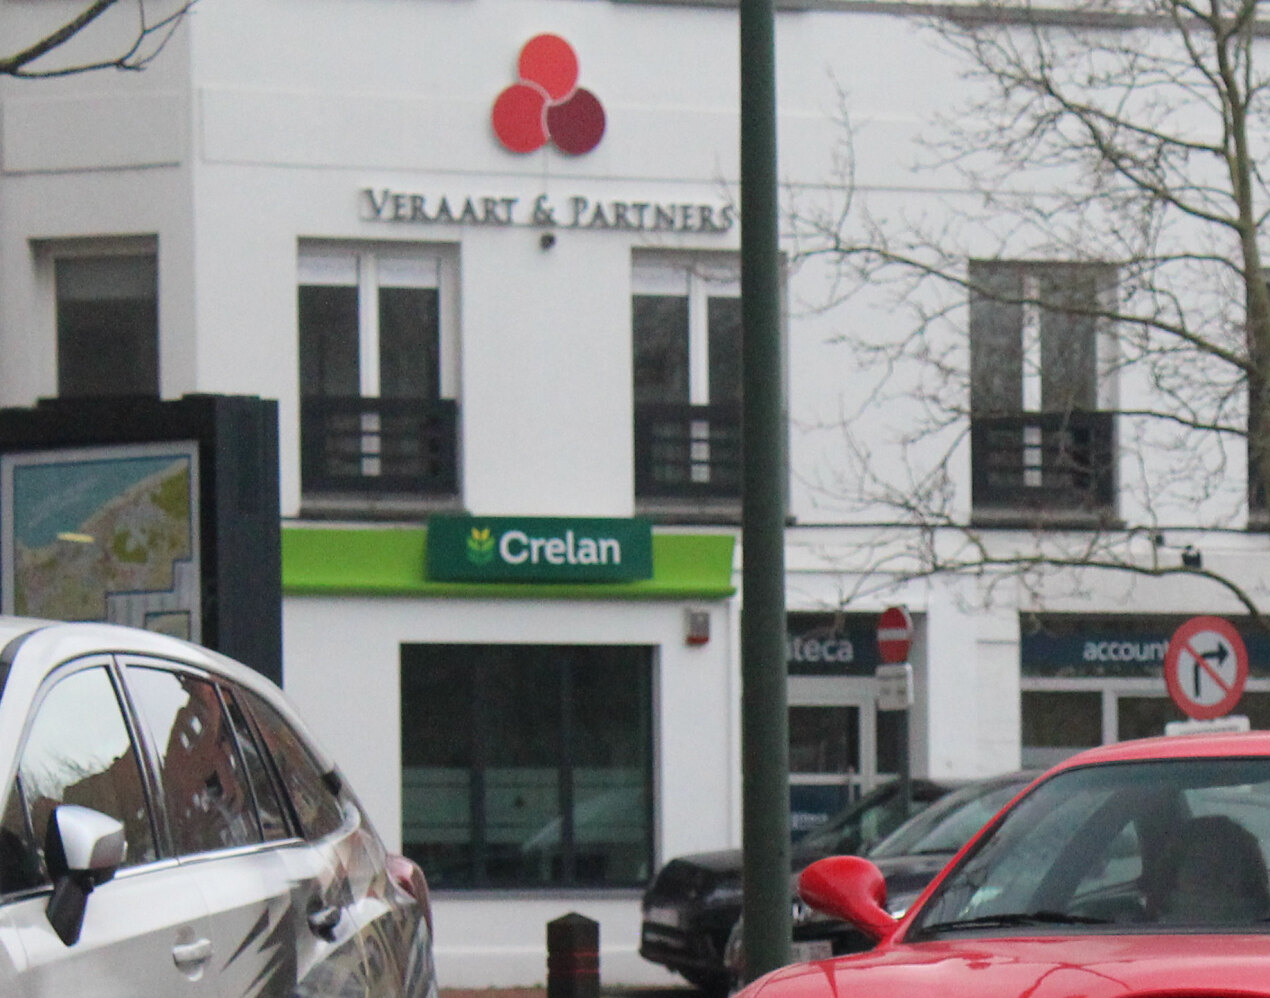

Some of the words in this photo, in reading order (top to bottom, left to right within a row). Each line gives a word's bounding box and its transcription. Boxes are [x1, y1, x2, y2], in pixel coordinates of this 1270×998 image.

[531, 193, 557, 227] &
[499, 529, 622, 565] Crelan
[785, 636, 855, 662] iteca
